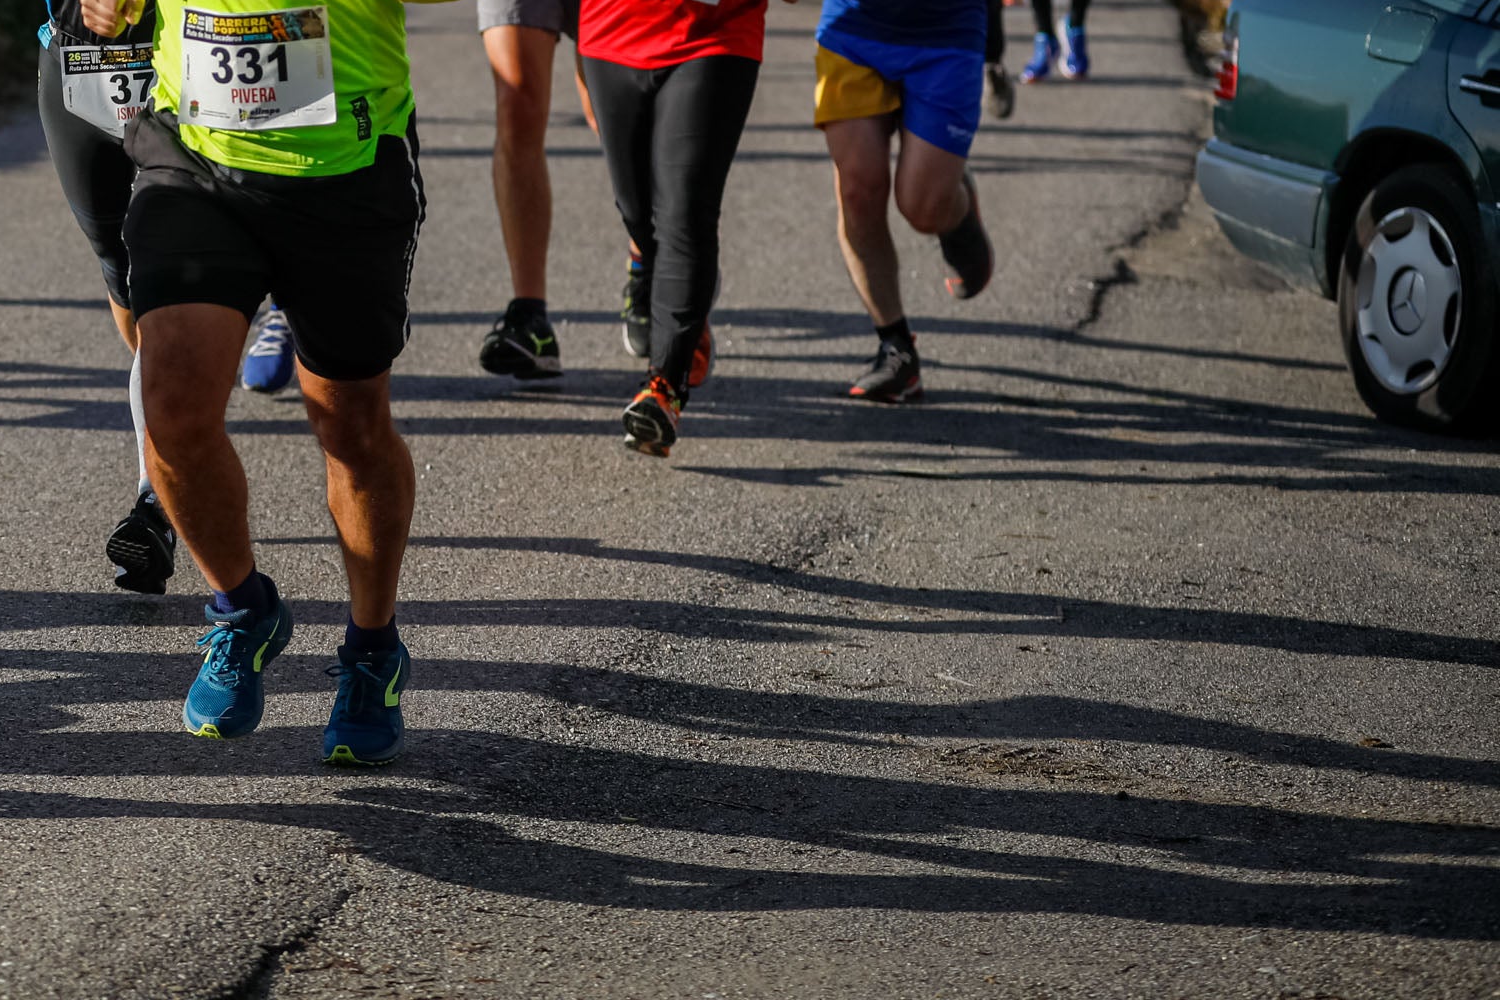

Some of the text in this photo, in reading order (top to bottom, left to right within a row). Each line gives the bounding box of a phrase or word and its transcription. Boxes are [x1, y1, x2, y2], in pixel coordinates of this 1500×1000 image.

[187, 12, 198, 25] 26
[213, 17, 269, 27] CARRERA
[213, 26, 268, 35] POPULAR
[68, 52, 81, 62] 26
[210, 44, 288, 85] 331
[231, 87, 277, 104] PIVERA
